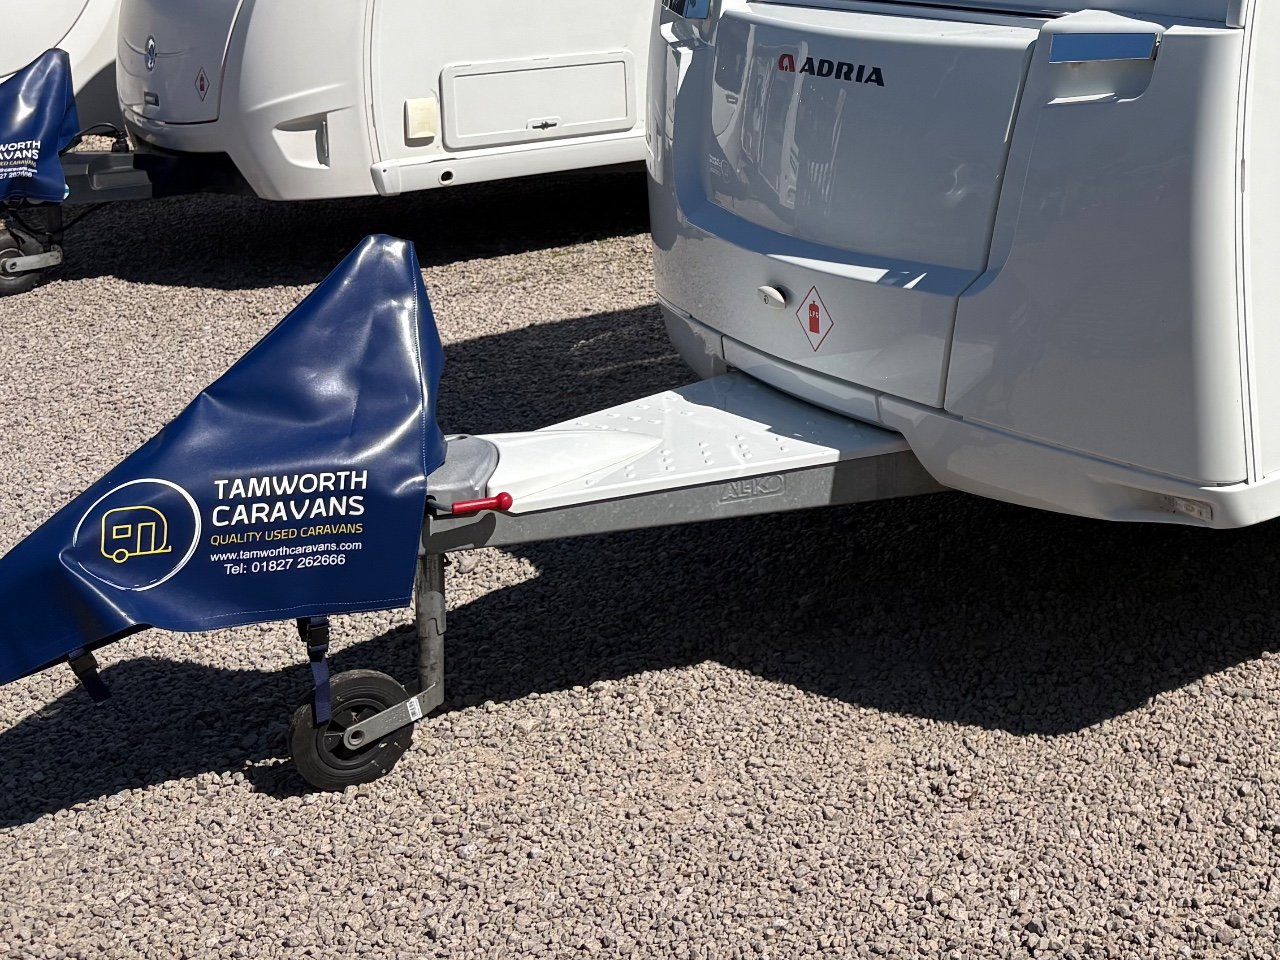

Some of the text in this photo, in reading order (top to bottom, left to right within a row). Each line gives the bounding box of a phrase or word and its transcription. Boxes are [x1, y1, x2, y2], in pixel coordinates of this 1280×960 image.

[800, 56, 885, 87] ADRIA
[214, 470, 368, 500] TAMWORTH
[212, 495, 365, 527] CARAVANS
[210, 523, 364, 546] QUALITY USED CARAVANS
[210, 542, 363, 562] www.tamworthcaravans.com
[224, 554, 346, 575] Tel: 01827 262666
